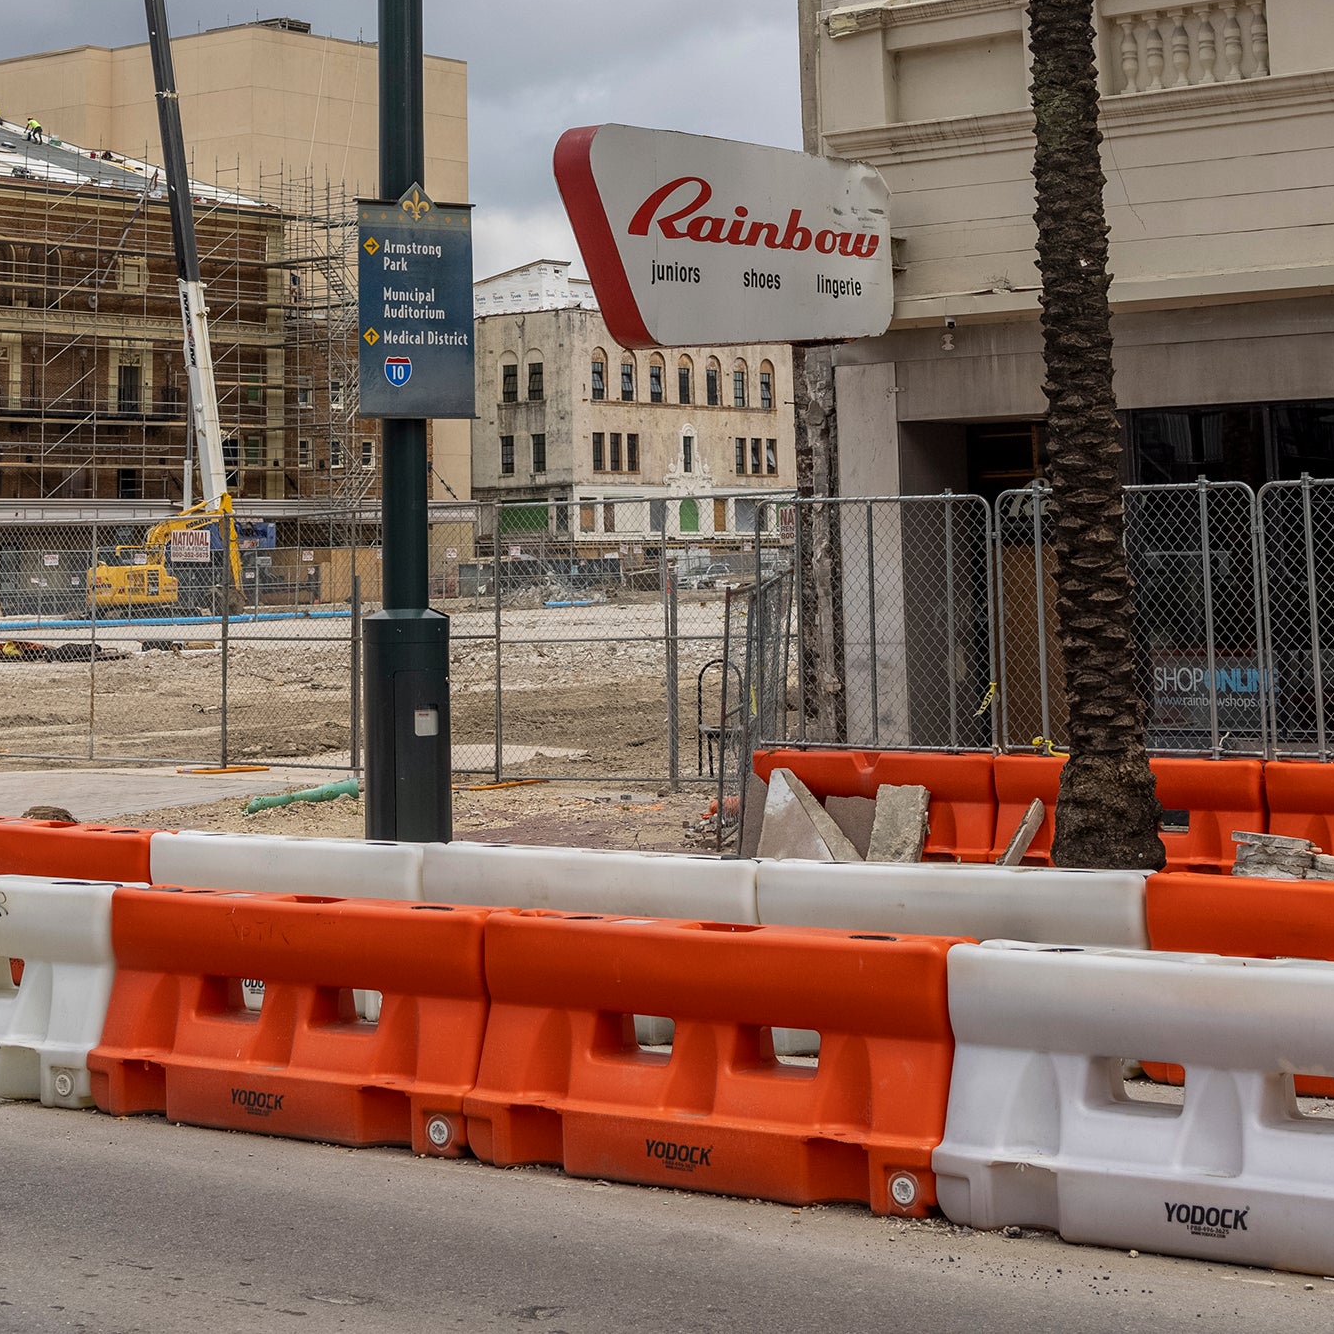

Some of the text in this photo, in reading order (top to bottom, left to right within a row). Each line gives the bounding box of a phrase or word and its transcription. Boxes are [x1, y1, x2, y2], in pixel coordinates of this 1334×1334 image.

[628, 177, 879, 258] Rainbow
[384, 239, 442, 258] Armstrong
[383, 257, 408, 271] Park
[651, 260, 862, 299] juniors shoes lingerie
[383, 287, 435, 304] Municipal
[384, 304, 445, 320] Auditorium
[384, 330, 468, 346] Medical District
[392, 366, 405, 380] 10
[172, 531, 209, 546] NATIONAL
[231, 1088, 284, 1110] YODOCK
[646, 1139, 712, 1166] YODOCK
[1164, 1202, 1248, 1230] YODOCK
